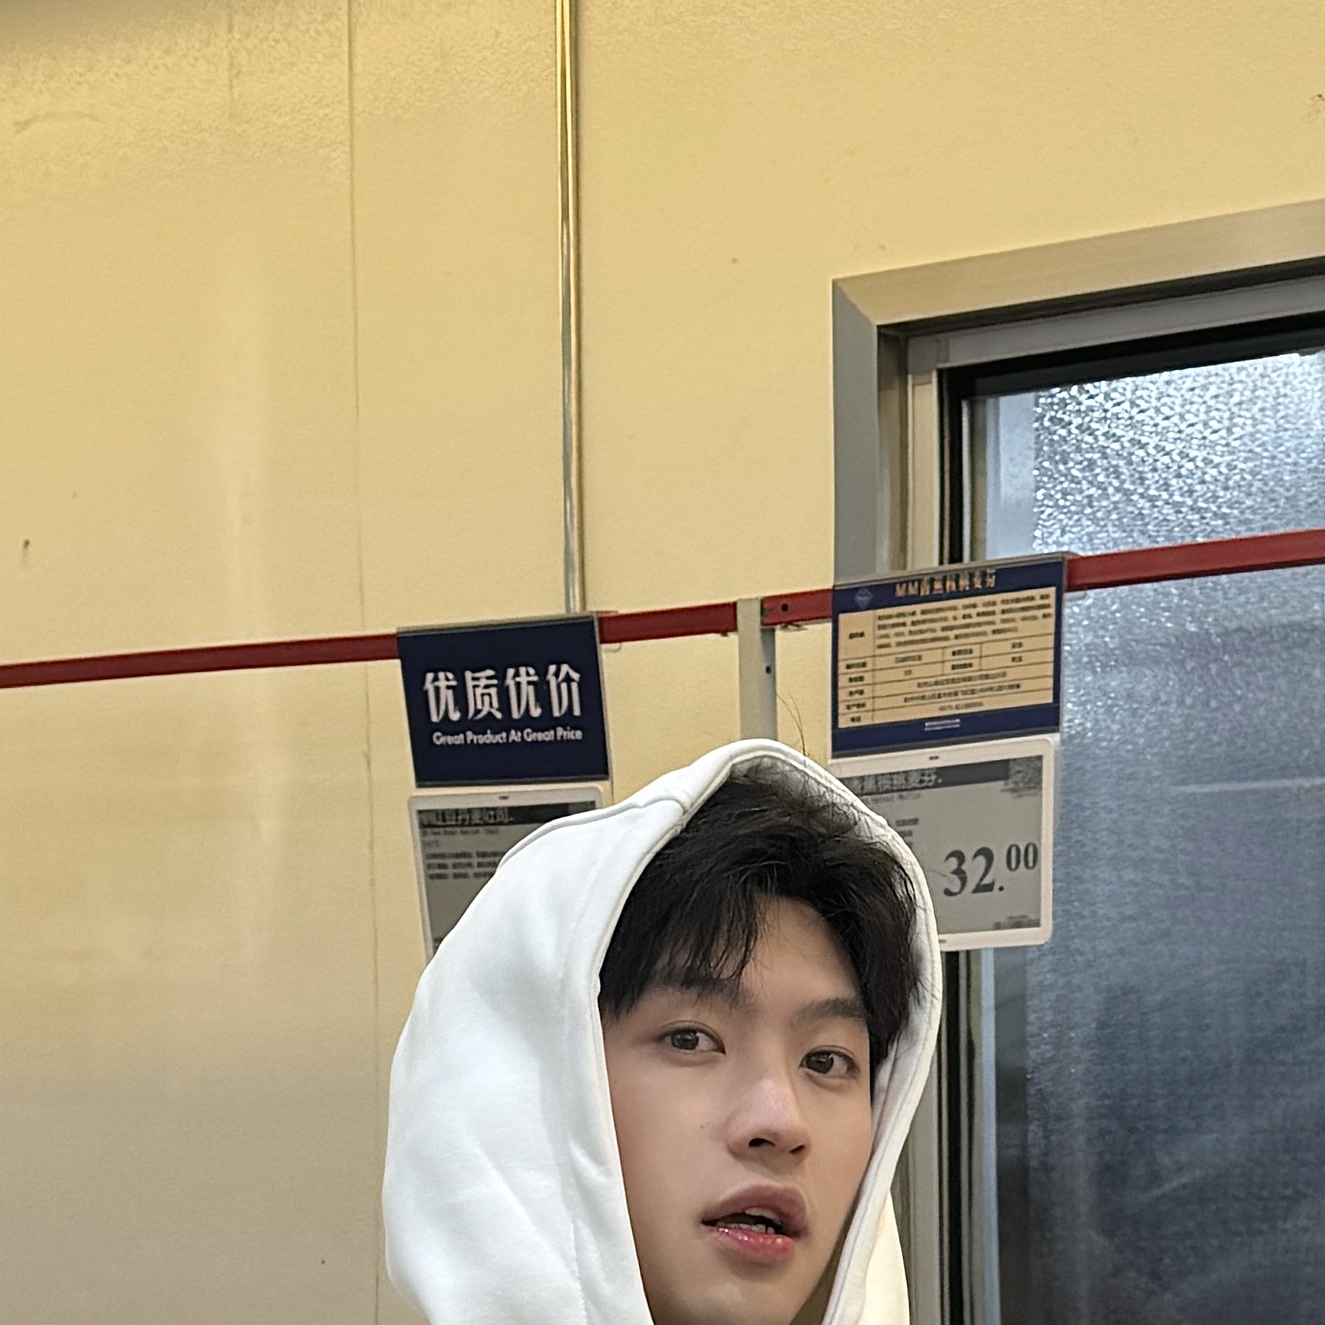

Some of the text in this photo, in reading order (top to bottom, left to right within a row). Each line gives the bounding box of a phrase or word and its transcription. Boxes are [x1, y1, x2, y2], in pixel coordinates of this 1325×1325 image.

[423, 663, 581, 722] 优质优价
[432, 726, 583, 745] Great Product At Great Price
[943, 842, 1038, 896] 32.00
